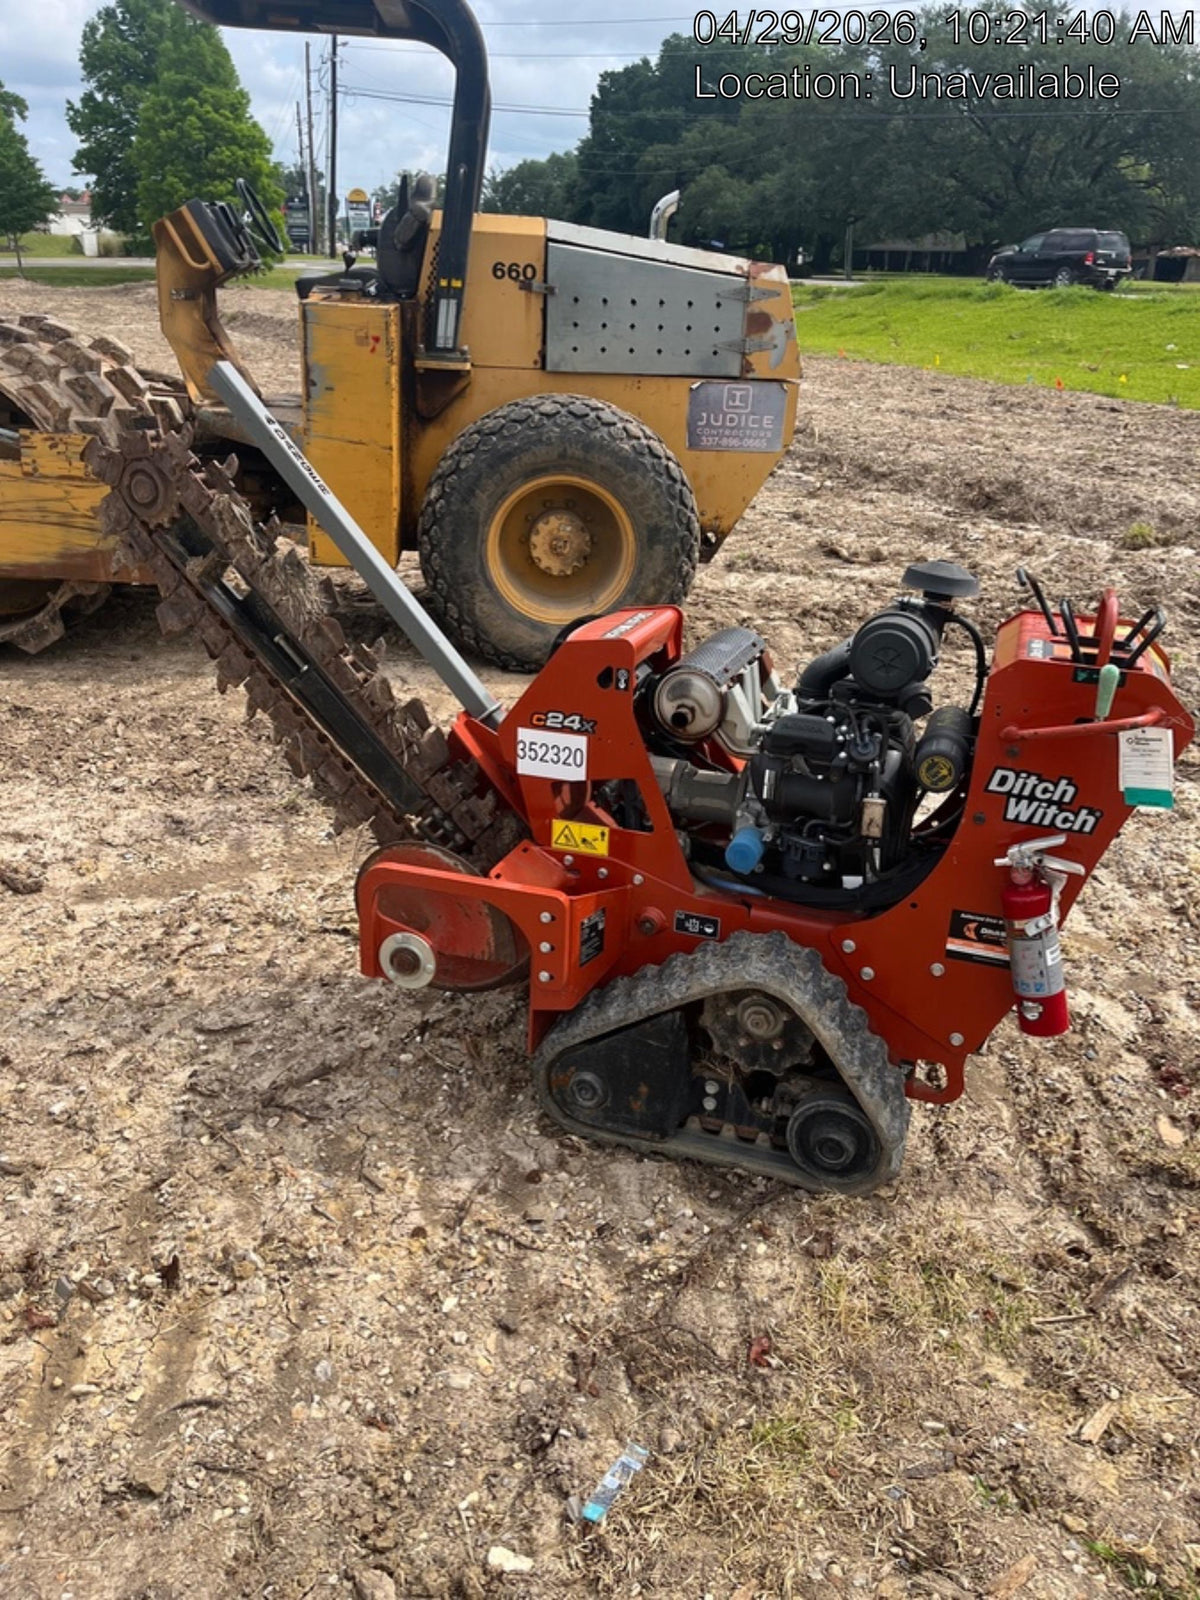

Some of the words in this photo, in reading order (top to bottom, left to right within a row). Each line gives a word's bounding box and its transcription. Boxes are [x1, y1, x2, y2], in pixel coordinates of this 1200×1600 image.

[492, 261, 537, 281] 660
[697, 412, 775, 428] JUDICE
[696, 427, 772, 438] CONTRACTORS
[516, 739, 584, 769] 352320
[987, 768, 1076, 803] Ditch
